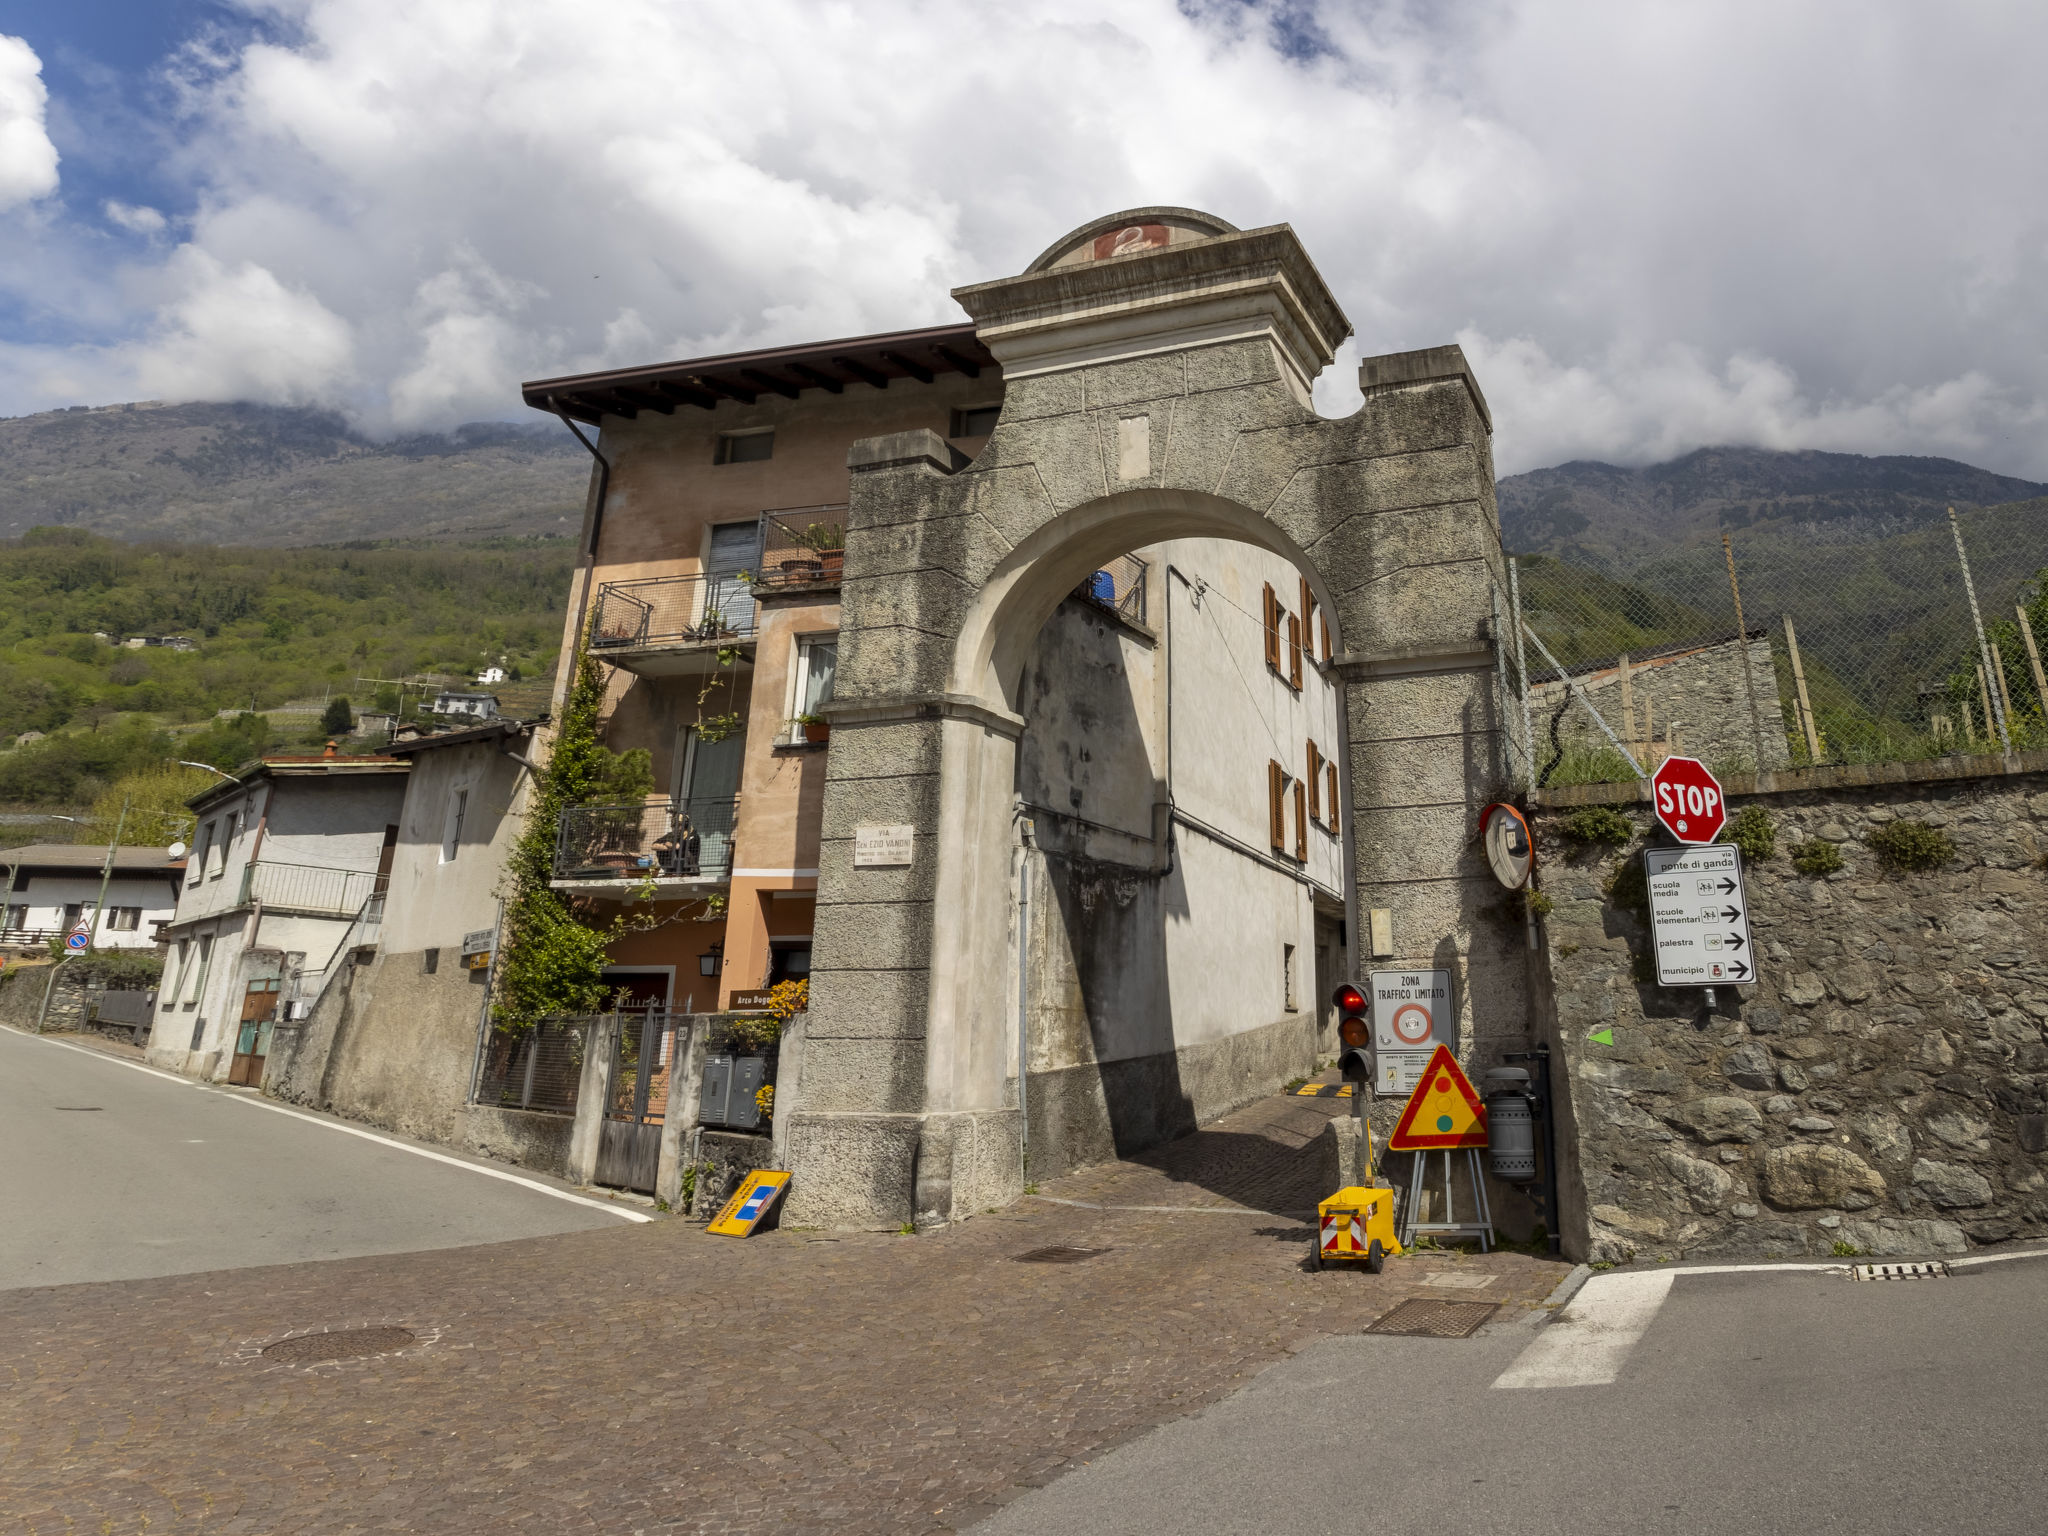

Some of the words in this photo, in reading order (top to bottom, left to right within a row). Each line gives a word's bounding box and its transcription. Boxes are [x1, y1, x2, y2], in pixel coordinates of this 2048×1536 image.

[1658, 782, 1718, 818] STOP
[1660, 861, 1689, 872] ponte
[1691, 860, 1700, 869] di
[1703, 858, 1733, 870] ganda
[1652, 881, 1681, 889] scuola
[1656, 908, 1684, 916] scuole
[1656, 916, 1701, 925] elementari
[1660, 939, 1694, 948] palestra
[1662, 967, 1704, 976] municipio
[1401, 976, 1420, 986] ZONA
[1378, 989, 1411, 1000] TRAFFICO
[1414, 988, 1445, 999] LIMITATO
